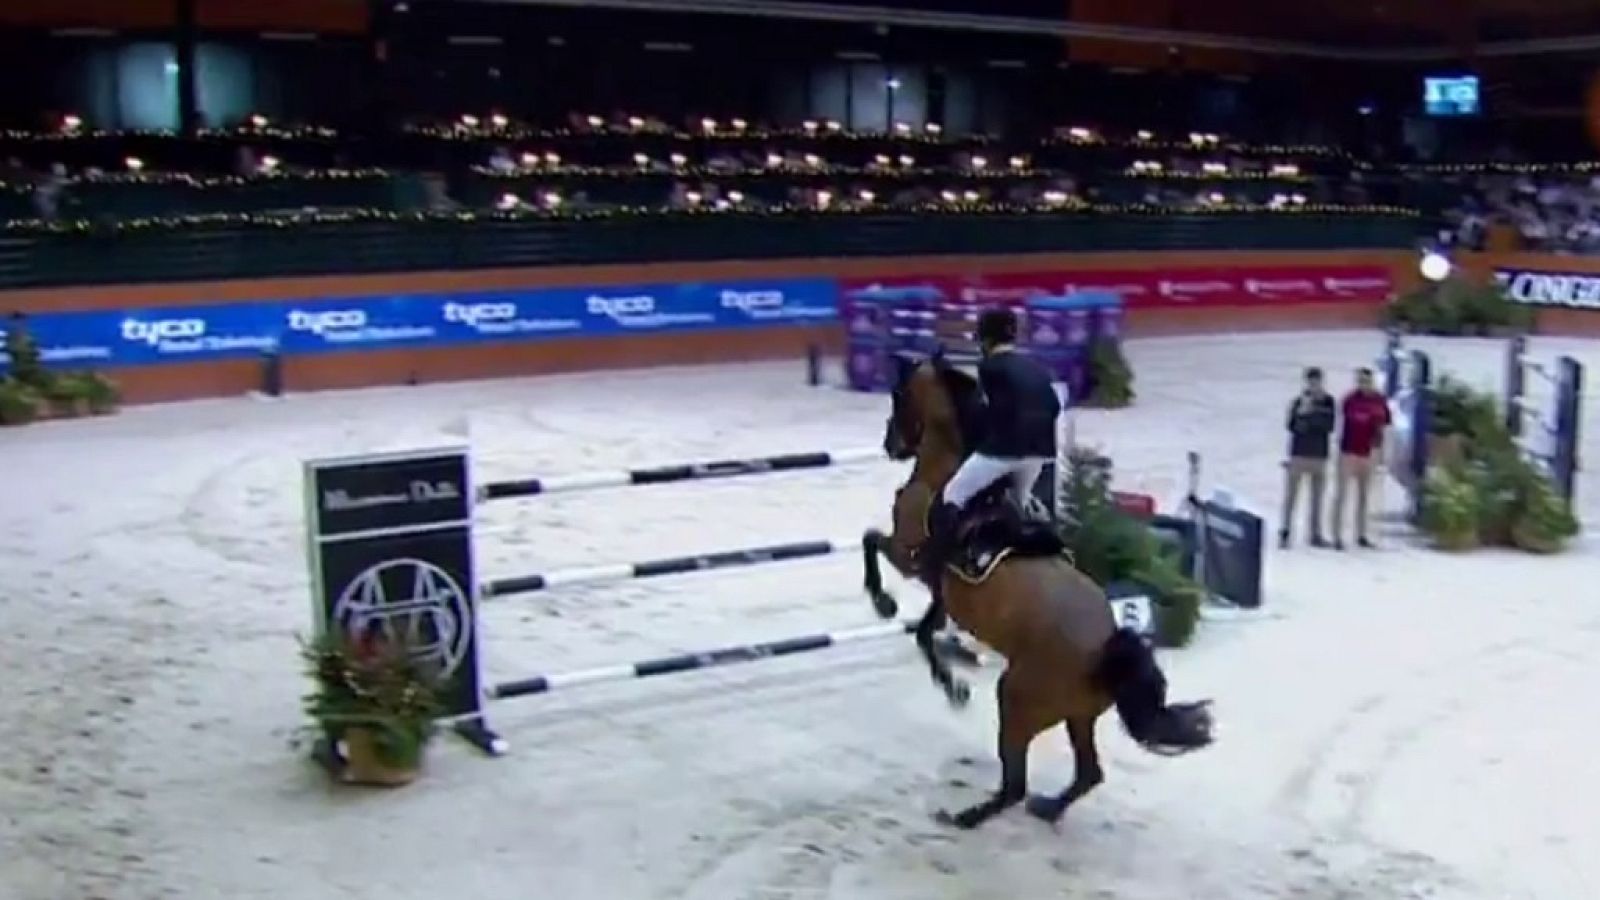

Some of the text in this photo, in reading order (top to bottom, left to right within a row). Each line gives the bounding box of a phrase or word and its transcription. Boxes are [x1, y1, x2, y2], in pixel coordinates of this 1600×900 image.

[444, 302, 517, 326] tyco
[587, 296, 654, 317] tyco
[121, 319, 205, 345] tyco
[287, 309, 366, 334] tyco
